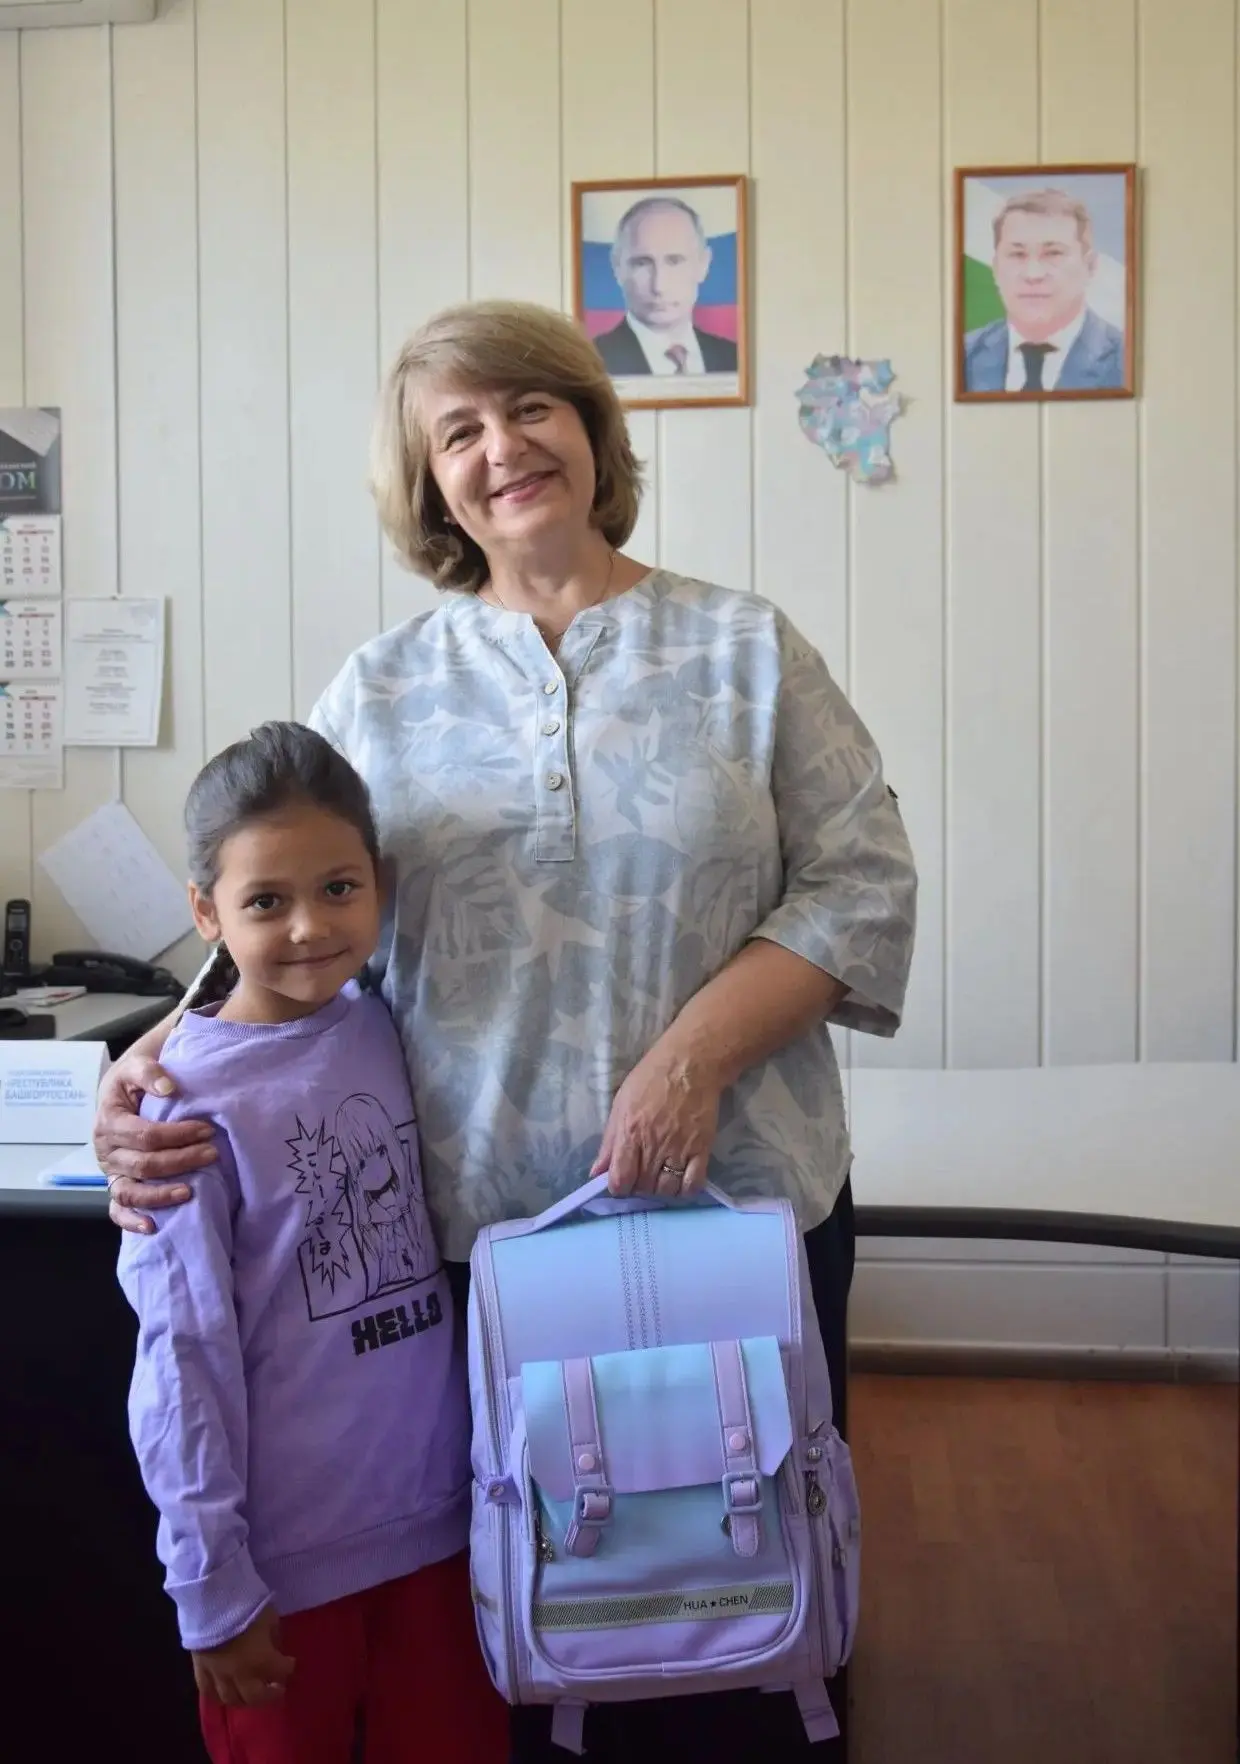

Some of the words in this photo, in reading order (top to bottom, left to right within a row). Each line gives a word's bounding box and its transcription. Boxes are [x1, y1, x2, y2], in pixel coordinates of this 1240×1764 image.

[352, 1292, 443, 1356] HELLO
[683, 1601, 708, 1611] HUA
[719, 1595, 749, 1607] CHEN
